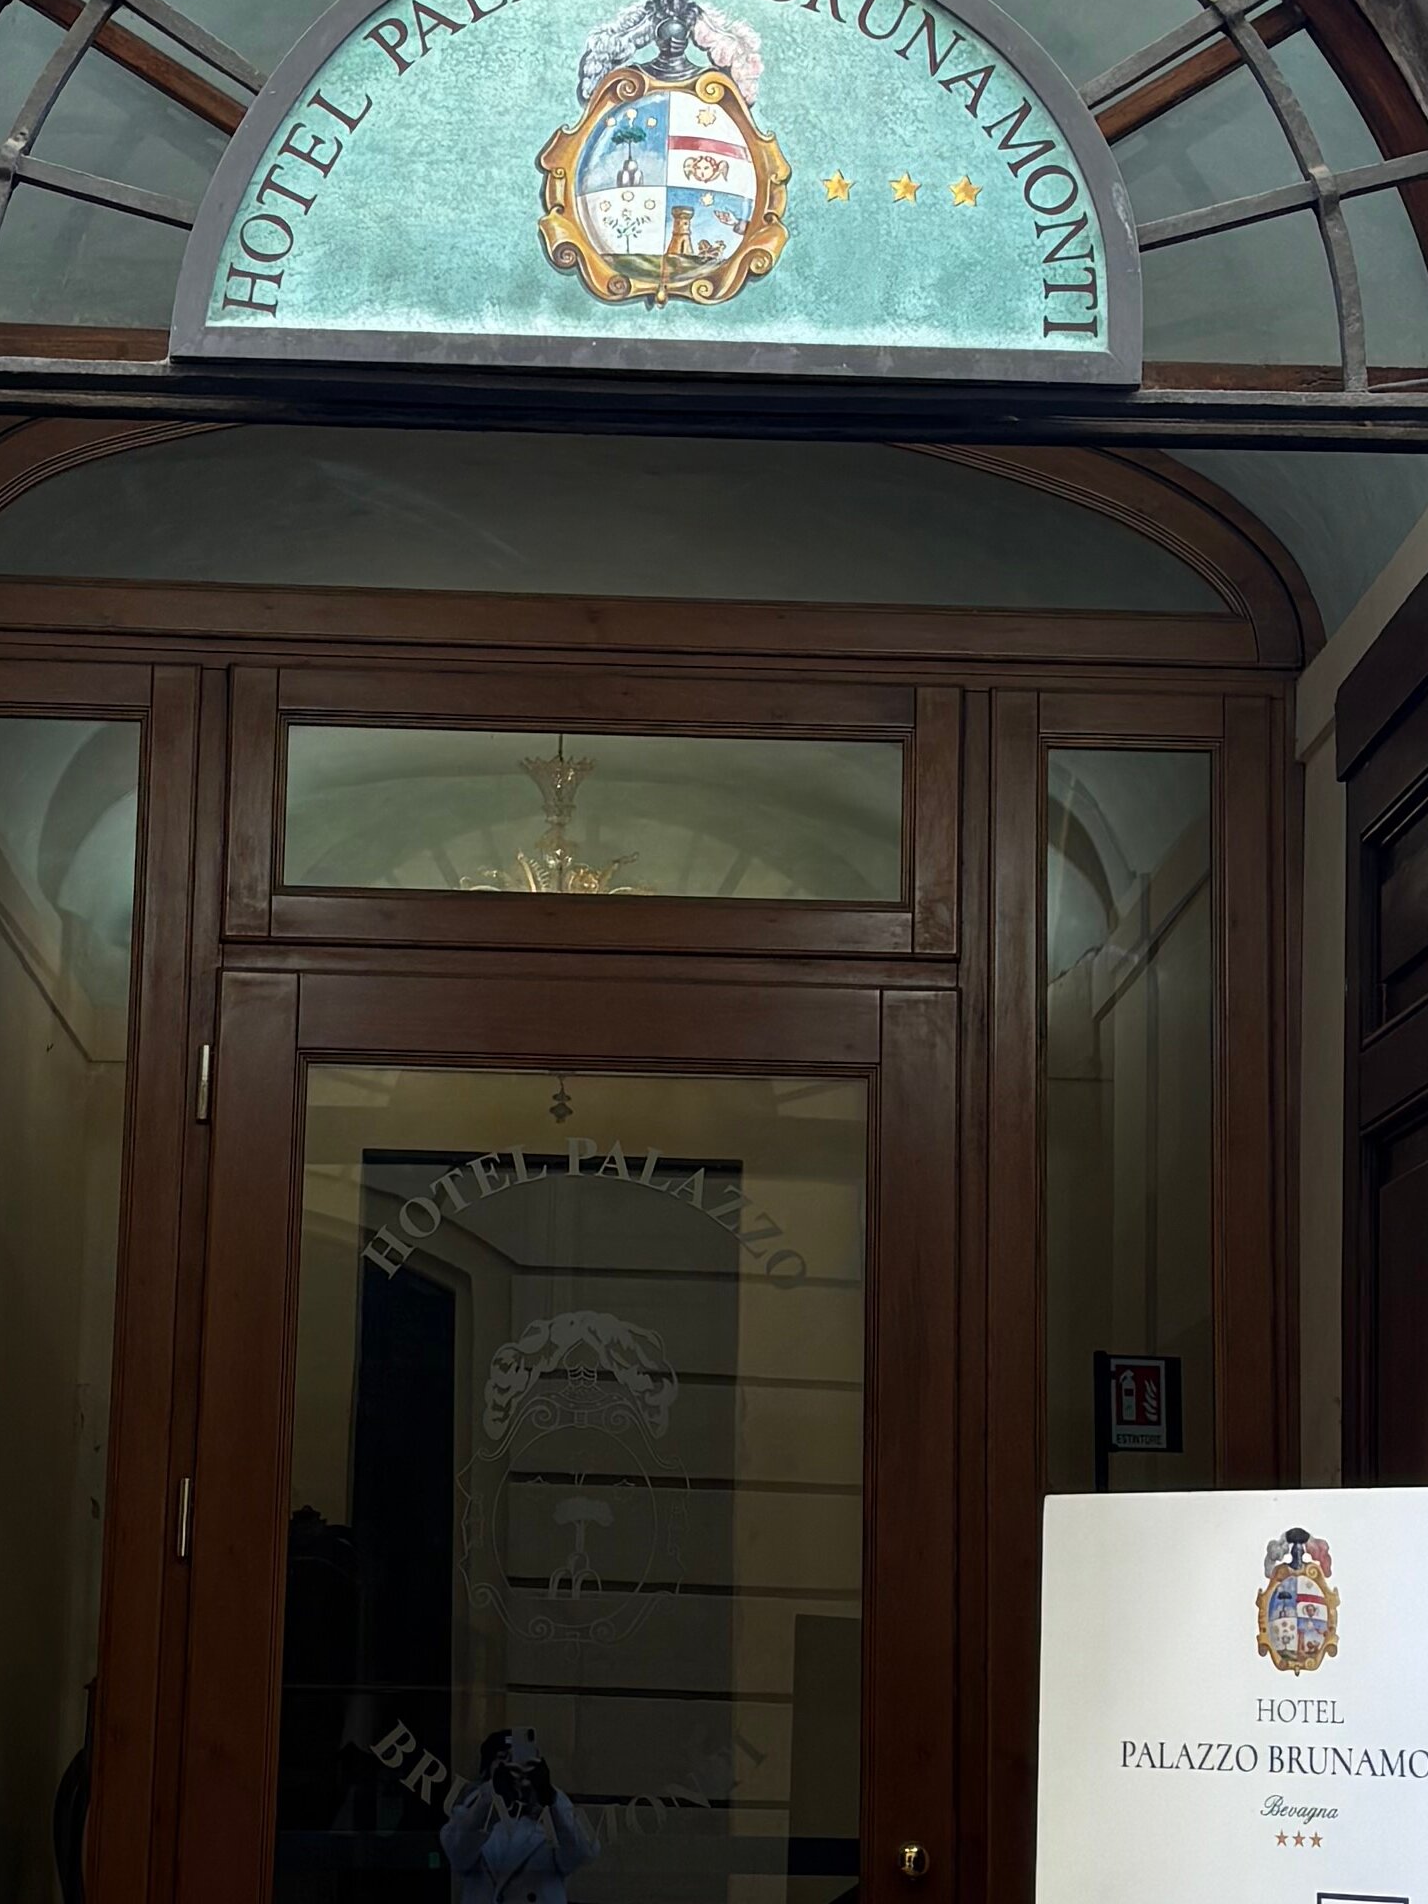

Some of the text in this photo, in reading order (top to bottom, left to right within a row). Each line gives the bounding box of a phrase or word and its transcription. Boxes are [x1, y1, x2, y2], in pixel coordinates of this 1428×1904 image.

[220, 91, 372, 318] HOTEL
[361, 1136, 807, 1290] HOTEL PALAZZO
[1256, 1698, 1345, 1724] HOTEL
[369, 1718, 767, 1848] BRUNAMONI
[1120, 1741, 1258, 1772] PALAZZO
[1260, 1794, 1339, 1824] Bevagna
